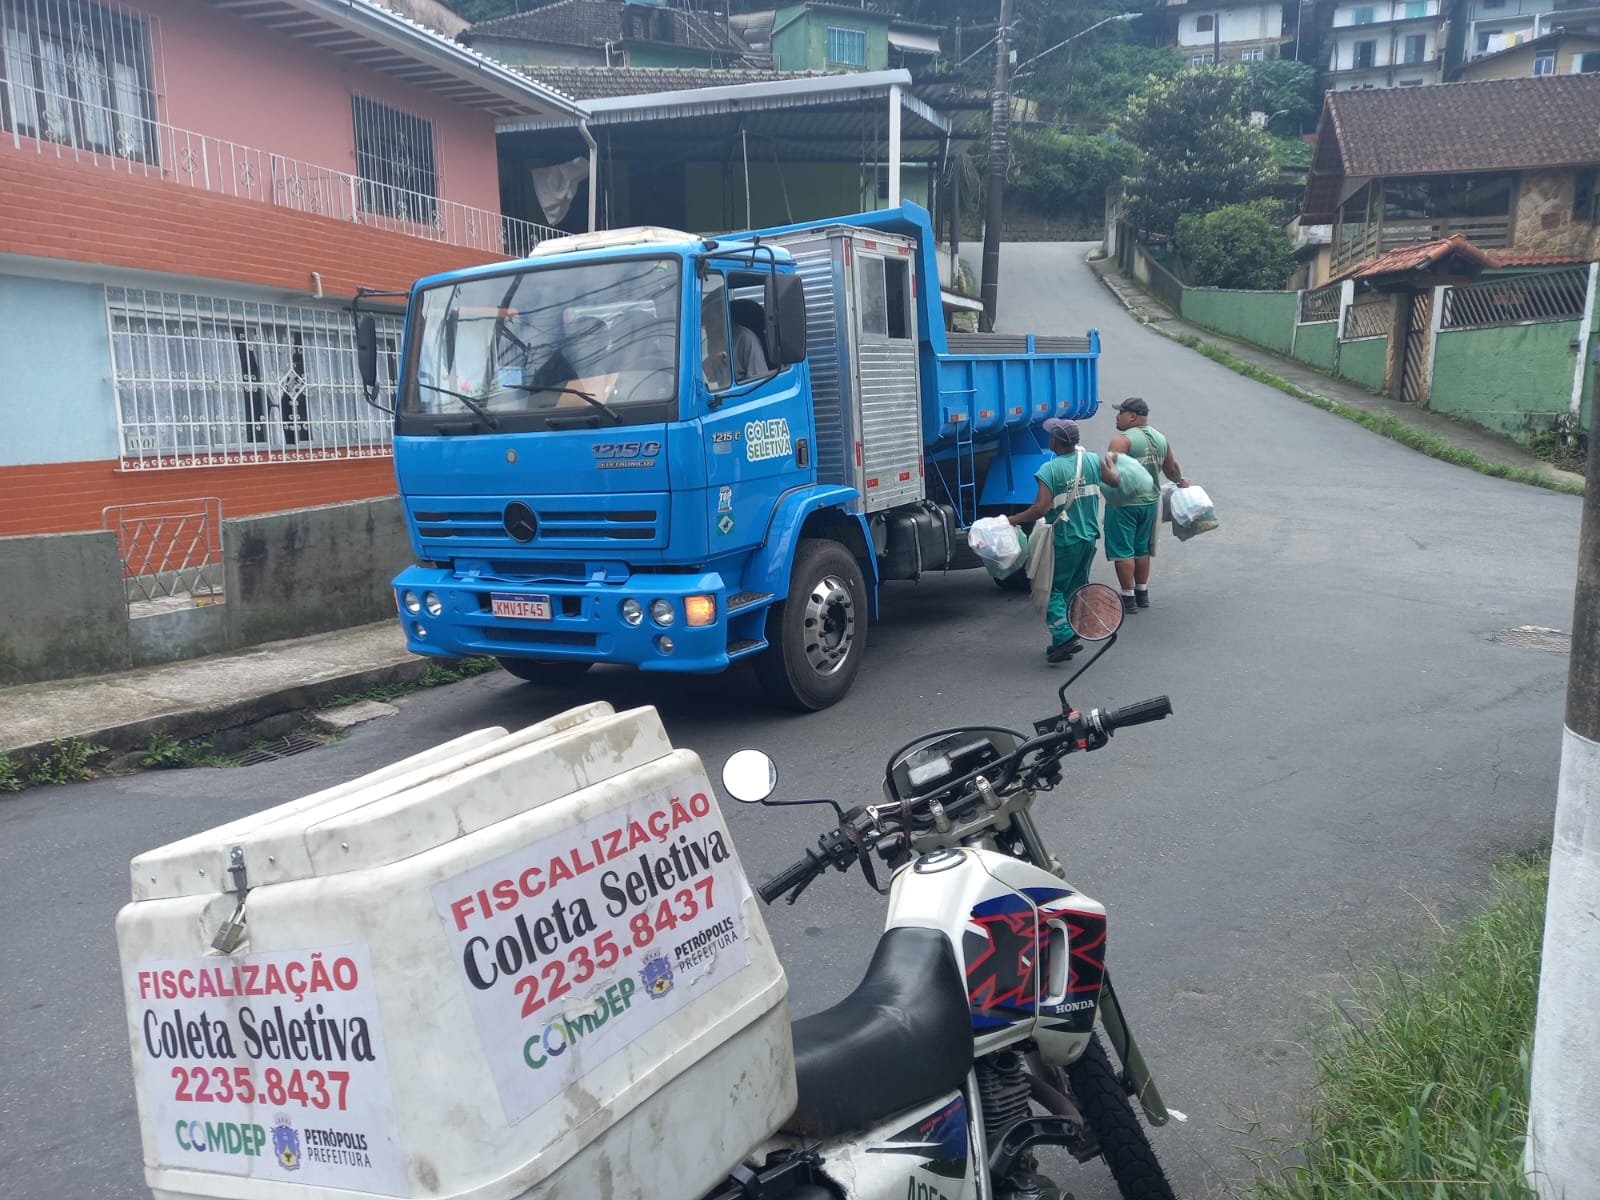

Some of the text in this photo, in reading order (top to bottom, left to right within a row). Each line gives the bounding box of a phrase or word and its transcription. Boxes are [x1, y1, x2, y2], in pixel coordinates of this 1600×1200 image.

[592, 442, 640, 458] 1215
[712, 432, 732, 442] 1215
[745, 418, 789, 442] COLETA
[747, 439, 792, 460] SELETIVA
[451, 792, 710, 932] FISCALIZAÇÃO
[462, 829, 731, 990] Coleta Seletiva
[513, 875, 715, 1019] 2235.8437
[674, 916, 734, 961] PETRÓPOLIS
[678, 930, 739, 974] PREFEITURA
[138, 952, 358, 1003] FISCALIZAÇÃO
[523, 976, 636, 1070] COMDEP
[1056, 999, 1095, 1014] HONDA
[143, 1003, 376, 1062] Coleta Seletiva
[171, 1066, 350, 1111] 2235.8437
[175, 1119, 266, 1157] COMDEP
[304, 1128, 368, 1151] PETRÓPOLIS
[307, 1147, 372, 1168] PREFEITURA
